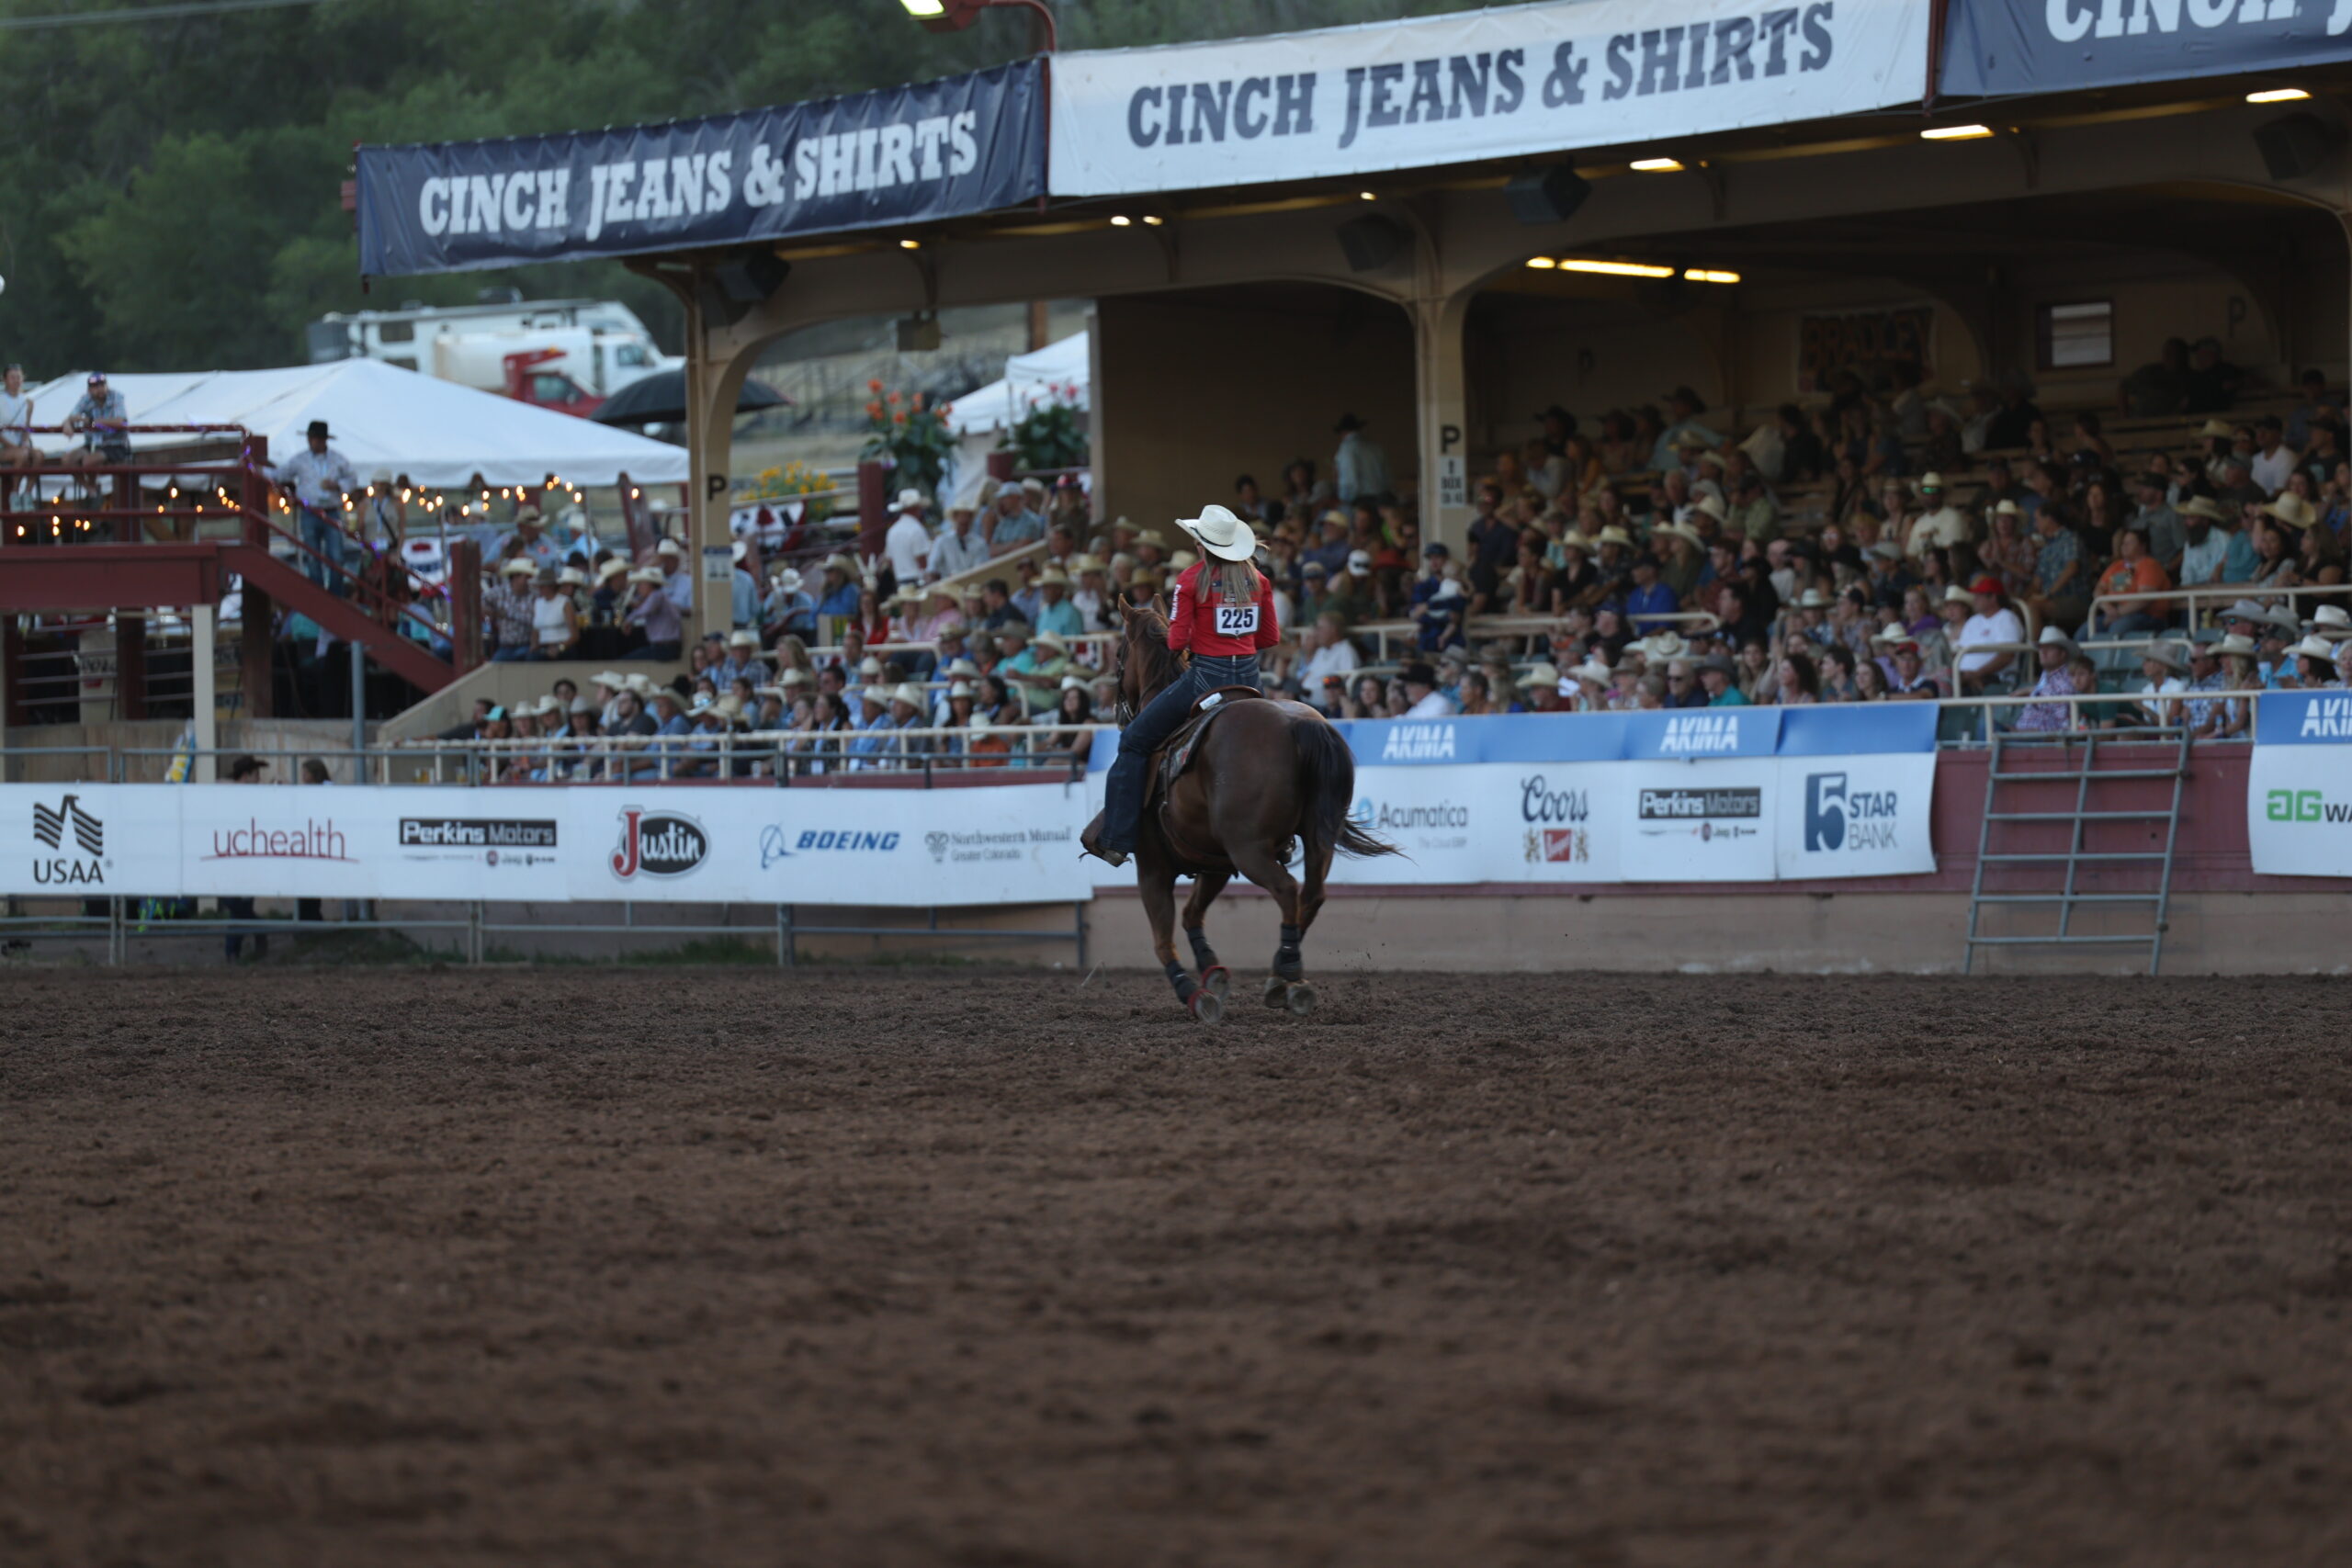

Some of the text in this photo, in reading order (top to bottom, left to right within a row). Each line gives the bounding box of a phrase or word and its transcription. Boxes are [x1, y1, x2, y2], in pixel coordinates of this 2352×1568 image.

[1128, 2, 1833, 150] CINCH JEANS & SHIRTS
[419, 110, 978, 243] CINCH JEANS & SHIRTS
[1440, 424, 1462, 455] P
[707, 474, 727, 501] P
[1221, 608, 1253, 629] 225
[2300, 698, 2352, 737] AKI
[1383, 724, 1455, 759] AKIMA
[1661, 715, 1737, 751] AKIMA
[1379, 798, 1467, 828] Acumatica
[1521, 774, 1589, 822] Coors
[1642, 790, 1758, 816] Perkins Motors
[1812, 773, 1846, 851] 5
[1849, 791, 1897, 818] STAR
[213, 817, 345, 859] uchealth
[402, 820, 554, 845] Perkins Motors
[611, 807, 701, 878] Justin
[796, 830, 900, 852] BOEING
[951, 828, 1071, 844] Northwestern Mutual
[1849, 822, 1897, 850] BANK
[34, 859, 104, 885] USAA
